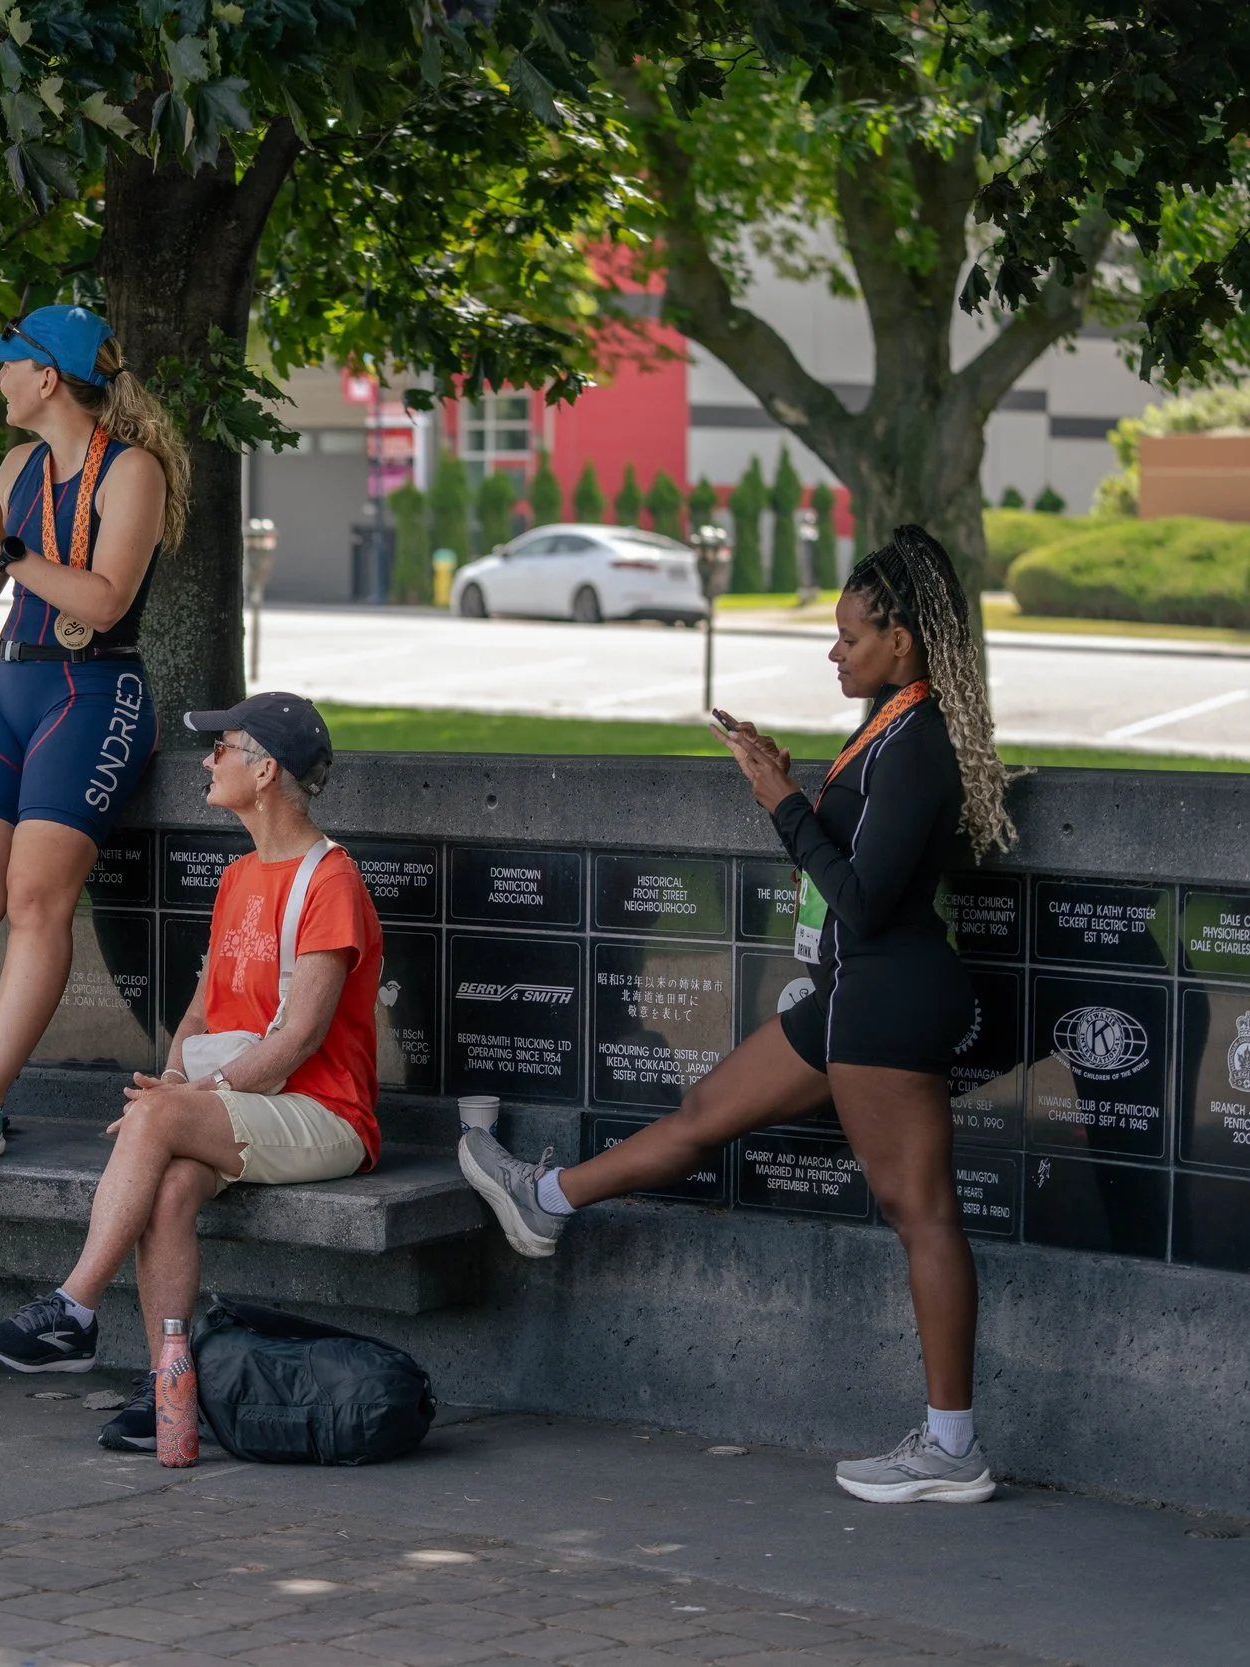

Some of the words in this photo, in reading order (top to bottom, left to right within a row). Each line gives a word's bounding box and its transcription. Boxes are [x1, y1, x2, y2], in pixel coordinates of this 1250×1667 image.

[85, 672, 143, 812] SUNDRIED
[125, 850, 142, 860] HAY
[187, 864, 211, 874] DUNC
[361, 861, 400, 873] DOROTHY
[403, 863, 434, 874] REDIVO
[490, 867, 541, 880] DOWNTOWN
[99, 873, 123, 884] 2003
[181, 876, 220, 888] MEIKLEJO
[414, 876, 427, 887] LTD
[637, 875, 683, 888] HISTORICAL
[374, 886, 399, 898] 2005
[493, 880, 537, 892] PENTICTON
[488, 892, 544, 905] ASSOCIATION
[633, 888, 660, 900] FRONT
[662, 889, 688, 901] STREET
[757, 888, 771, 899] THE
[624, 900, 697, 914] NEIGHBOURHOOD
[776, 902, 795, 914] RAC
[978, 896, 1014, 909] CHURCH
[1049, 901, 1071, 914] CLAY
[1074, 904, 1093, 916] AND
[1096, 905, 1124, 918] KATHY
[963, 909, 1016, 922] COMMUNITY
[1220, 913, 1241, 926] DALE
[962, 922, 986, 934] SINCE
[989, 924, 1008, 936] 1926
[1058, 916, 1088, 929] ECKERT
[1091, 919, 1128, 932] ELECTRIC
[1131, 921, 1146, 933] LTD
[1084, 932, 1097, 943] EST
[1100, 933, 1119, 945] 1964
[1190, 939, 1211, 952] DALE
[73, 972, 84, 982] DR
[114, 974, 148, 986] MCLEOD
[124, 987, 142, 997] AND
[458, 982, 508, 996] BERRY
[510, 993, 519, 1001] &
[522, 990, 572, 1004] SMITH
[621, 989, 699, 1007] 北海道池田町に
[628, 1004, 692, 1022] 敬意を表して
[457, 1032, 511, 1047] BERRY&SMITH
[514, 1036, 555, 1050] TRUCKING
[558, 1039, 572, 1051] LTD
[467, 1046, 513, 1060] OPERATING
[515, 1050, 540, 1062] SINCE
[543, 1051, 562, 1063] 1954
[598, 1042, 650, 1057] HONOURING
[653, 1046, 671, 1058] OUR
[674, 1049, 698, 1060] SISTER
[701, 1051, 720, 1062] CITY
[467, 1058, 495, 1071] THANK
[498, 1060, 515, 1073] YOU
[517, 1062, 562, 1076] PENTICTON
[606, 1056, 632, 1069] IKEDA,
[635, 1058, 682, 1073] HOKKAIDO,
[1083, 1071, 1111, 1081] CHILDREN
[1112, 1072, 1120, 1080] OF
[1120, 1069, 1132, 1078] THE
[1132, 1058, 1150, 1074] WORLD
[612, 1069, 637, 1082] SISTER
[639, 1071, 658, 1083] CITY
[661, 1073, 685, 1085] SINCE
[1038, 1095, 1072, 1109] KIWANIS
[1075, 1098, 1096, 1111] CLUB
[1099, 1101, 1111, 1112] OF
[1114, 1102, 1159, 1118] PENTICTON
[1210, 1101, 1246, 1116] BRANCH
[952, 1115, 964, 1125] AN
[983, 1116, 1005, 1129] 1990
[1048, 1109, 1096, 1125] CHARTERED
[1098, 1114, 1117, 1127] SEPT
[1119, 1117, 1126, 1128] 4
[1129, 1118, 1148, 1131] 1945
[745, 1150, 773, 1164] GARRY
[776, 1154, 796, 1166] AND
[798, 1155, 833, 1169] MARCIA
[755, 1164, 792, 1178] MARRIED
[795, 1167, 804, 1179] IN
[807, 1169, 851, 1184] PENTICTON
[956, 1169, 999, 1184] MILLINGTON
[766, 1178, 809, 1192] SEPTEMBER
[812, 1182, 818, 1195] 1,
[821, 1183, 839, 1196] 1962
[963, 1187, 984, 1199] HEARTS
[962, 1203, 981, 1216] SISTER
[982, 1204, 988, 1216] &
[989, 1205, 1010, 1219] FRIEND
